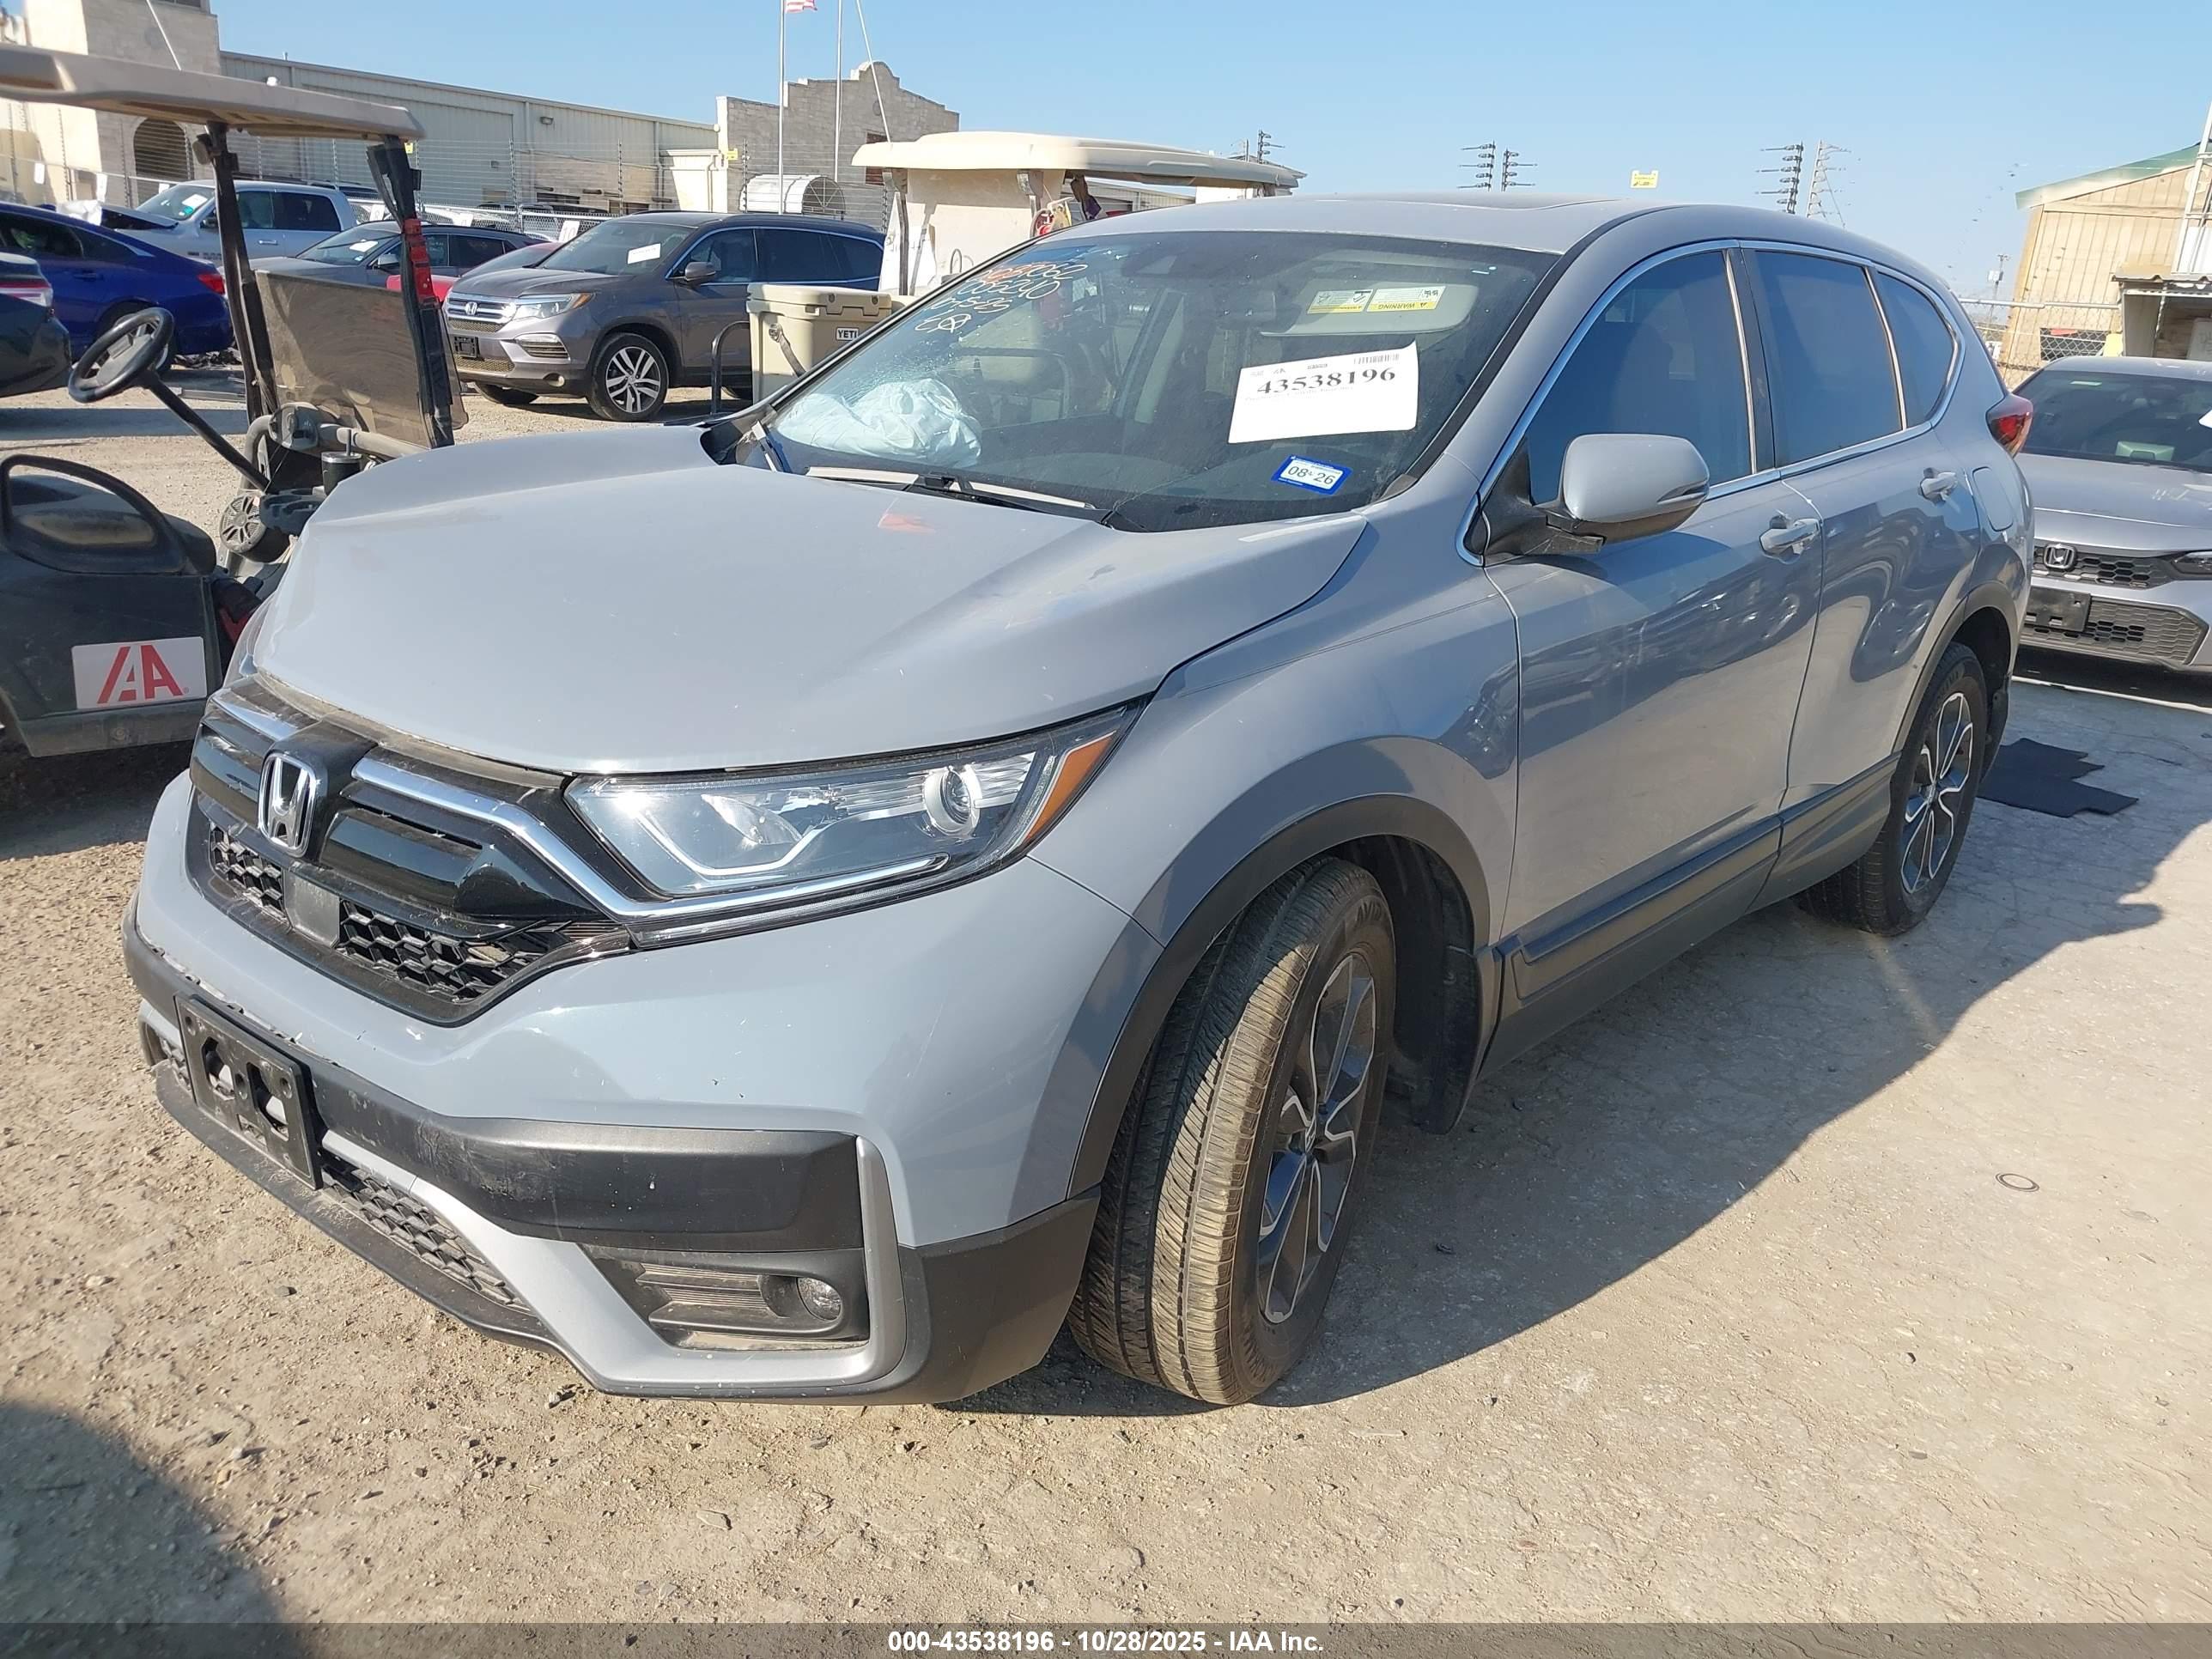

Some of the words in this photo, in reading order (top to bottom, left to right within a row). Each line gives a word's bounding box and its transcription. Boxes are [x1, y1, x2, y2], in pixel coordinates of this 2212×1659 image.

[838, 330, 857, 338] YETI
[1257, 368, 1396, 394] 43538196
[1287, 465, 1309, 478] 08
[1313, 472, 1336, 485] 26
